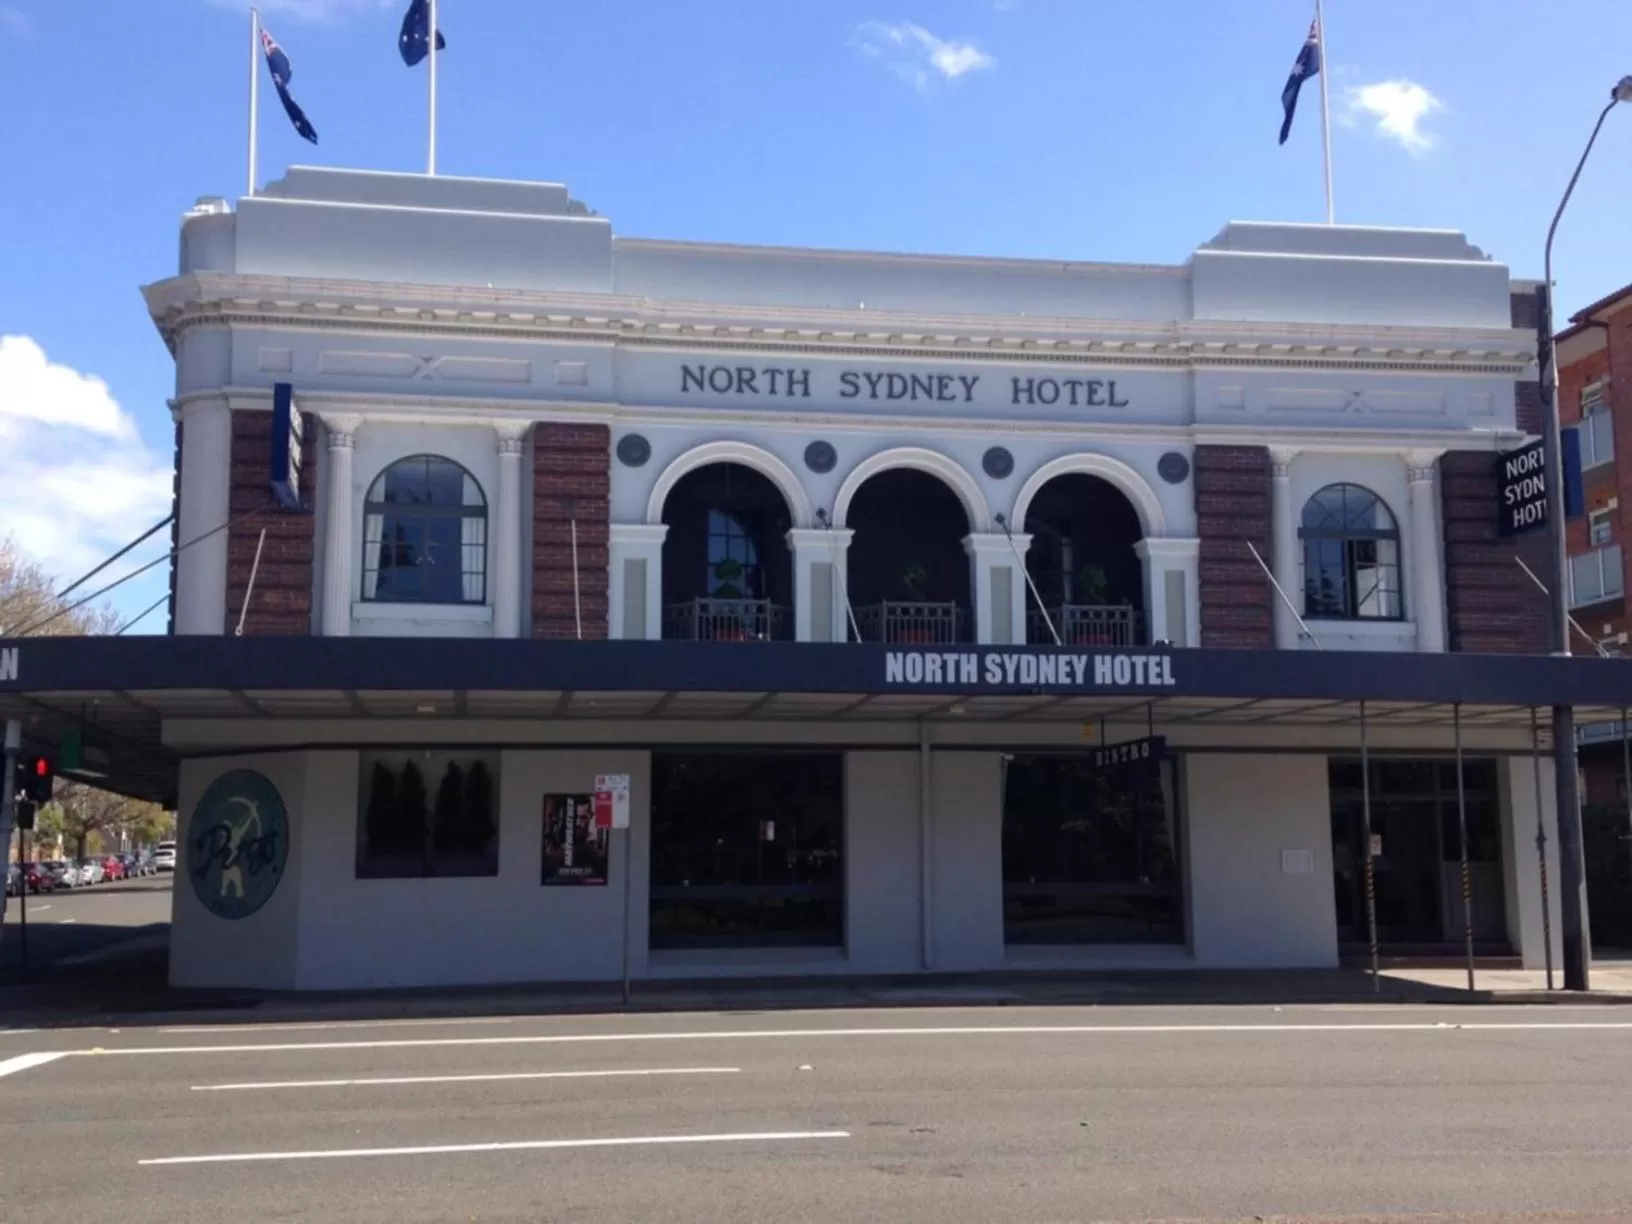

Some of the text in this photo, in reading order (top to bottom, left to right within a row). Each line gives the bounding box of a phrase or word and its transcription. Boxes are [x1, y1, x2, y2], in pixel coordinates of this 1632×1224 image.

[680, 364, 1130, 408] NORTH SYDNEY HOTEL
[0, 647, 18, 680] N
[886, 652, 1176, 686] NORTH SYDNEY HOTEL
[1096, 741, 1150, 768] BISTRO
